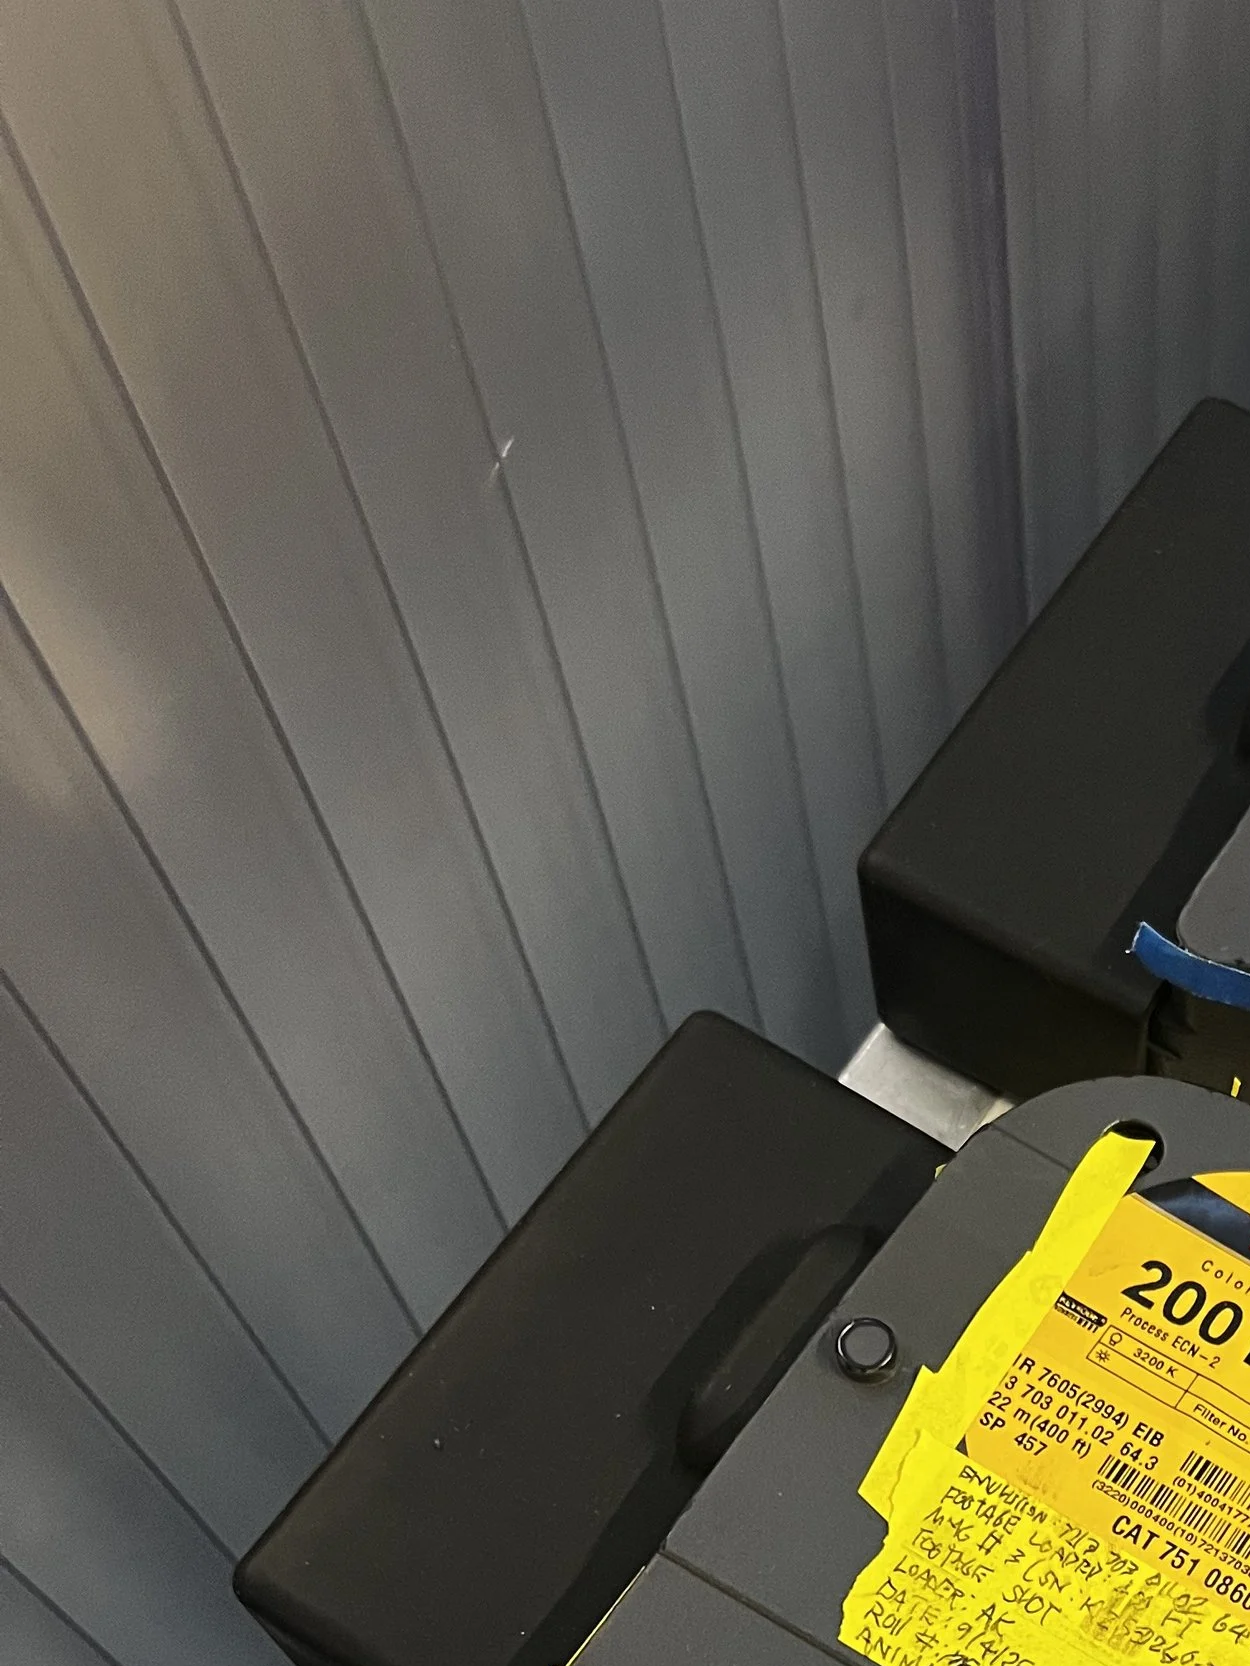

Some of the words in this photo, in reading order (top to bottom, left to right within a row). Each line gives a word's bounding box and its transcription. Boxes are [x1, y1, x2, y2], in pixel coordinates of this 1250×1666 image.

[1120, 1306, 1169, 1341] Process
[1132, 1347, 1164, 1370] 3200
[1165, 1365, 1178, 1378] K
[987, 1390, 1011, 1412] 22
[1071, 1437, 1091, 1459] ft)
[1020, 1383, 1053, 1410] 703
[1055, 1404, 1114, 1446] 011.02
[1119, 1441, 1158, 1470] 64.3
[1037, 1366, 1129, 1430] 7605(2994)
[1131, 1421, 1164, 1447] EIB
[1192, 1403, 1226, 1428] Filter
[1227, 1424, 1247, 1444] No.
[979, 1411, 1005, 1430] SP
[1014, 1432, 1047, 1456] 457
[1111, 1515, 1159, 1550] CAT
[1158, 1540, 1200, 1575] 751
[973, 1602, 1015, 1640] AK
